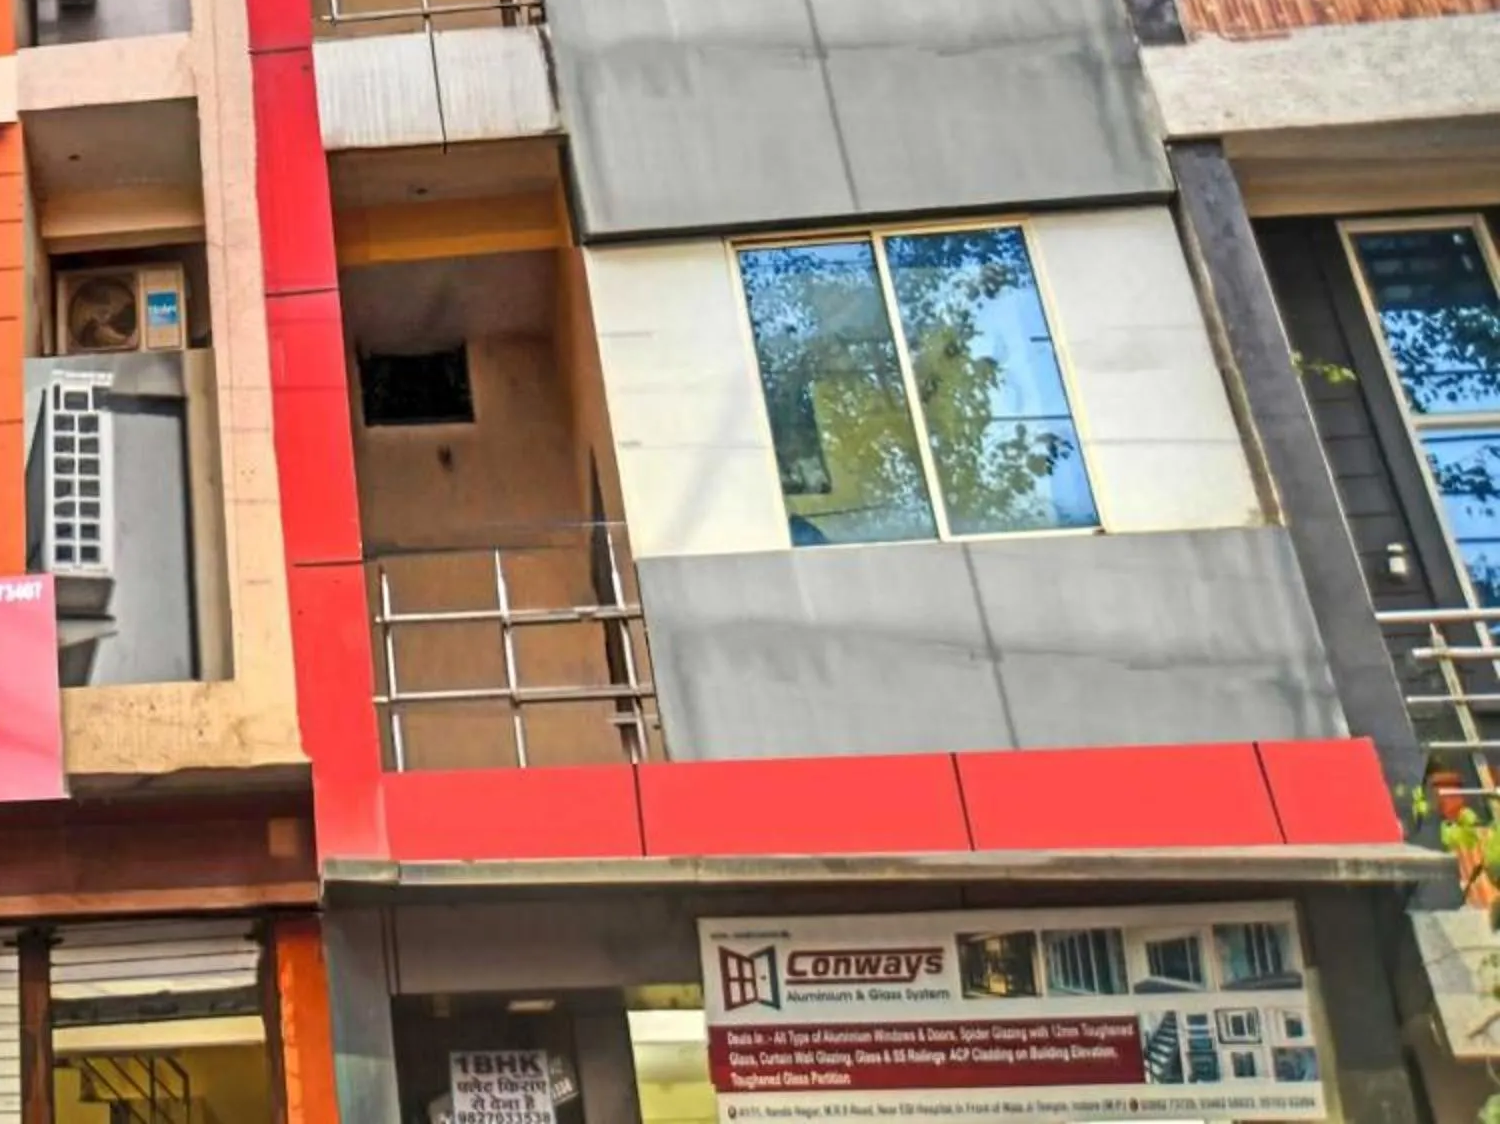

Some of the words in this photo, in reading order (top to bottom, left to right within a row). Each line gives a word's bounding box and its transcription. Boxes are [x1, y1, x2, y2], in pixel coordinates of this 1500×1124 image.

[785, 946, 946, 985] Conways
[786, 988, 852, 1003] Aluminium
[869, 988, 902, 1002] Glass
[905, 987, 951, 1002] System
[454, 1053, 542, 1075] 1BHK
